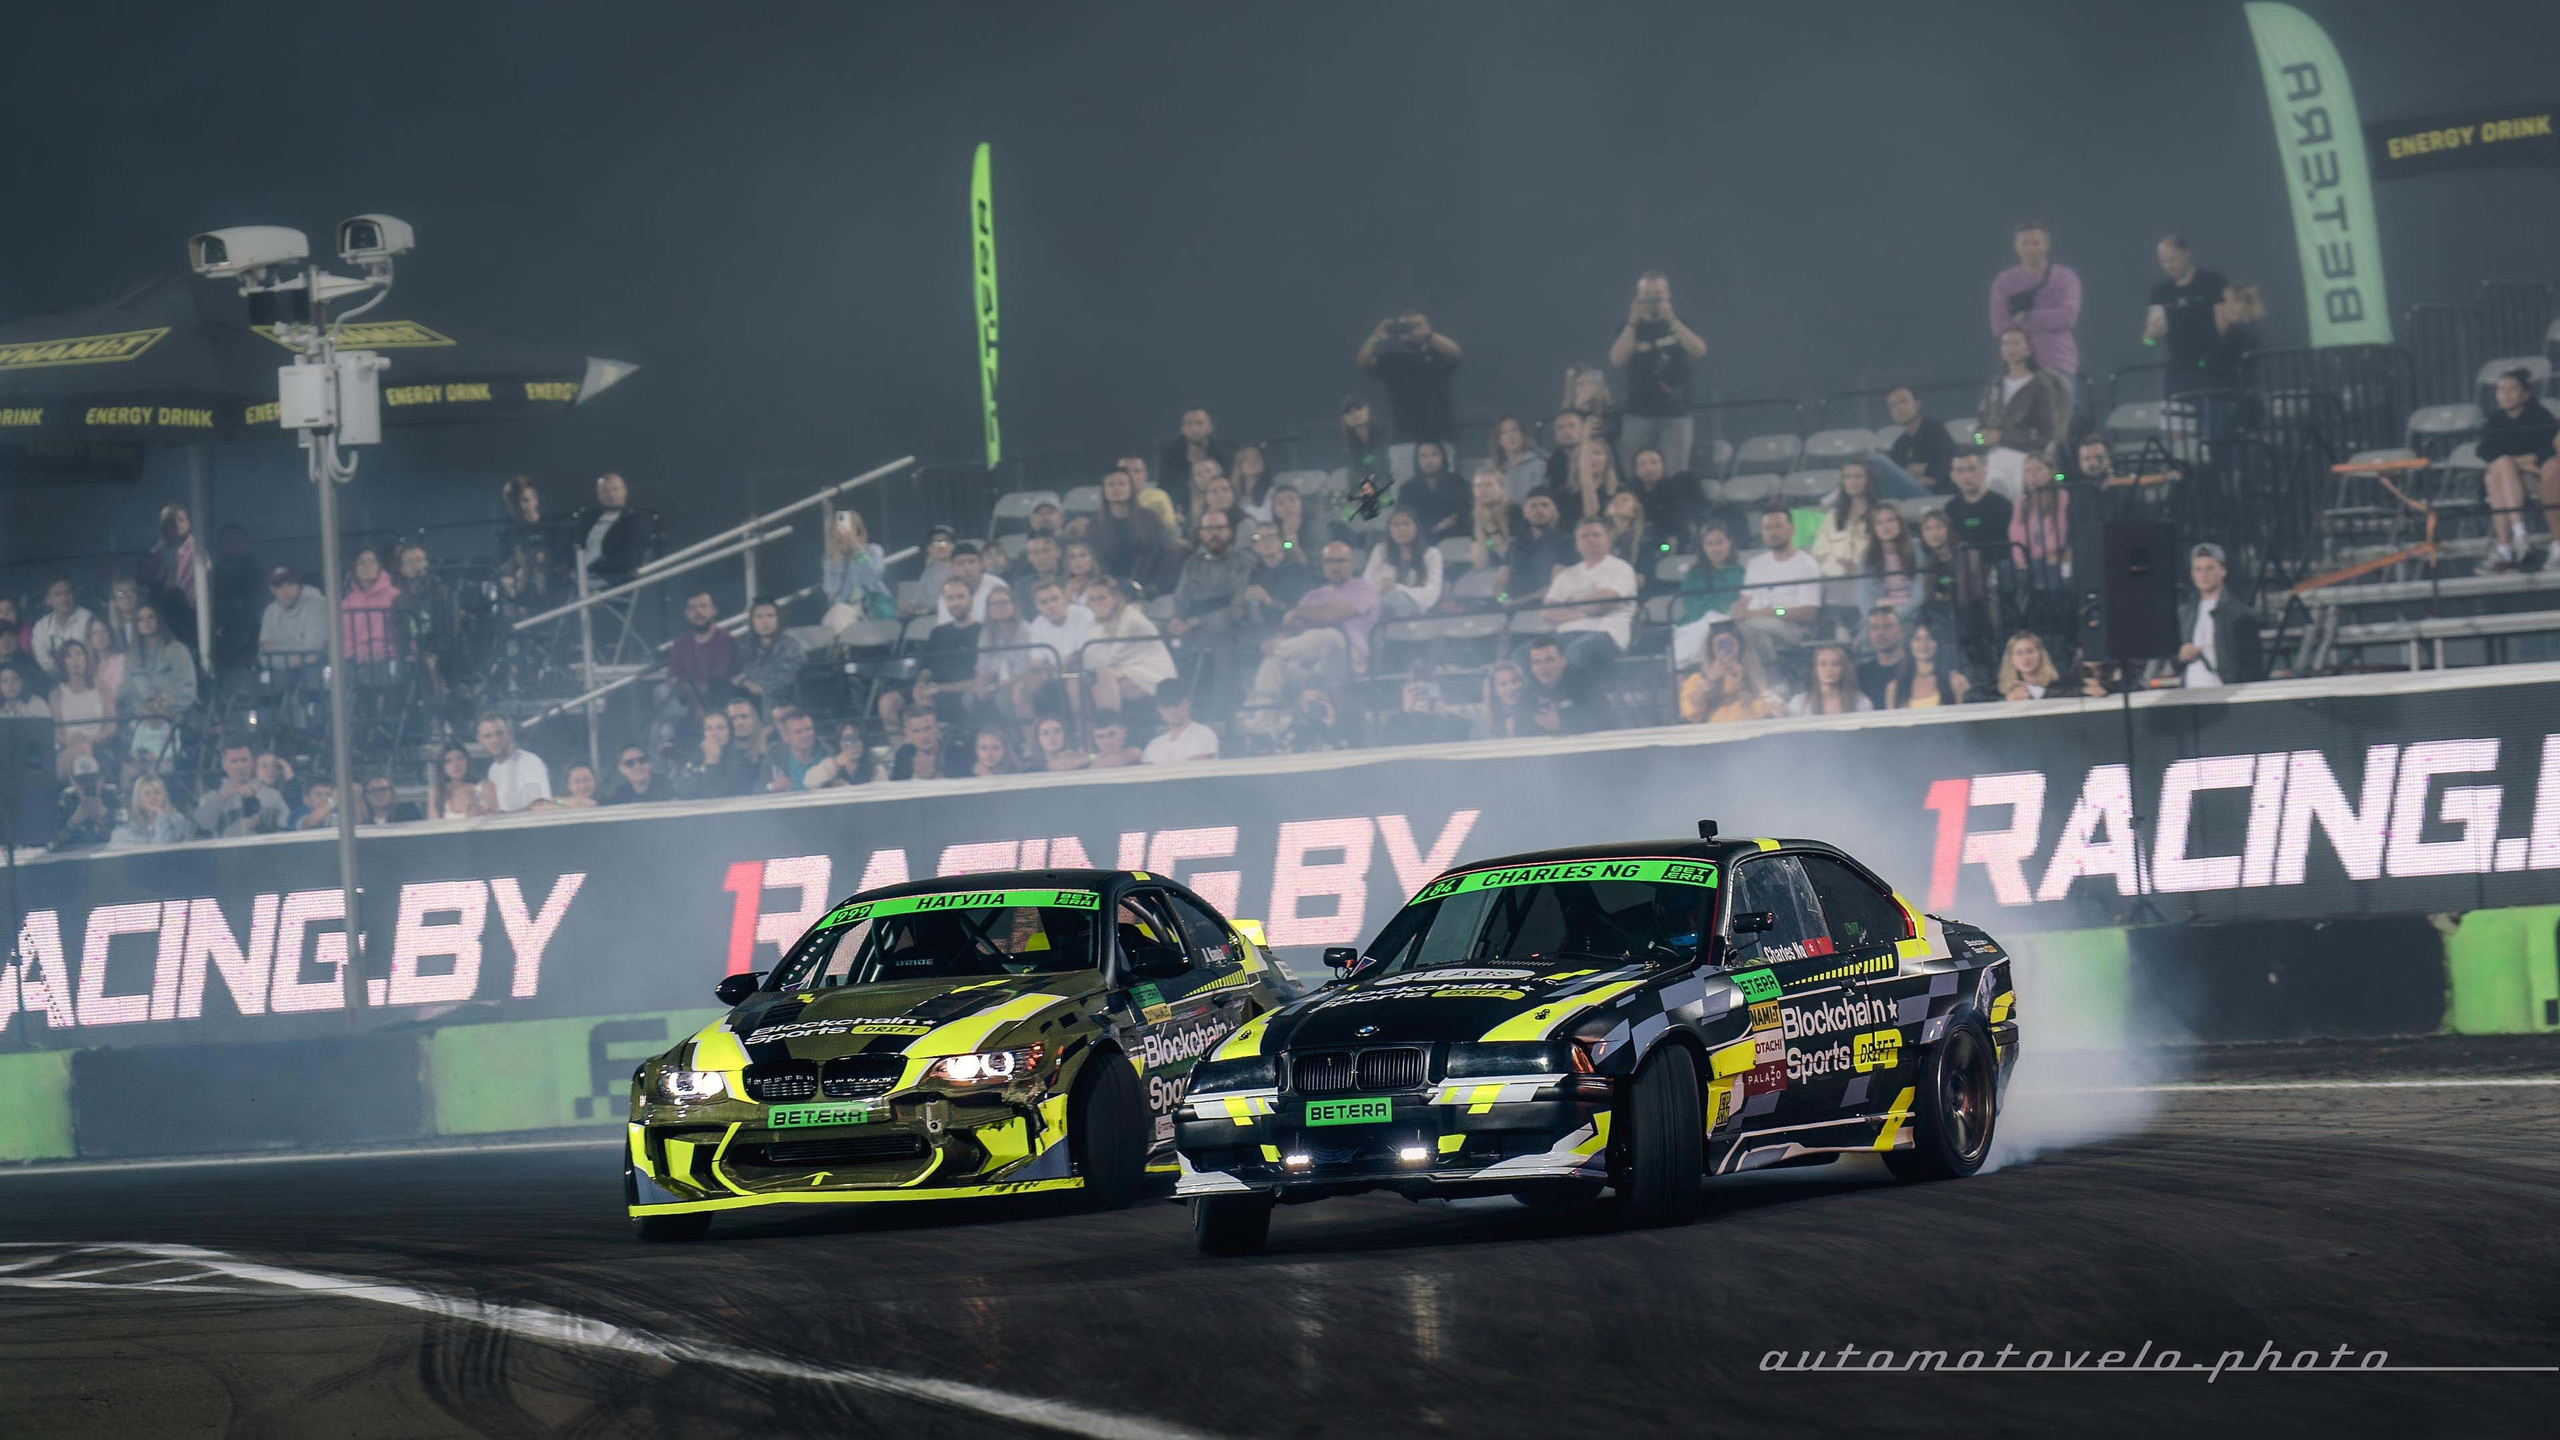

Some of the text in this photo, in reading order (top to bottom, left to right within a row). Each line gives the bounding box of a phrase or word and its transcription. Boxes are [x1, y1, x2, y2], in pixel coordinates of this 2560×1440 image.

[2387, 114, 2552, 159] ENERGY DRINK
[386, 382, 492, 406] ENERGY DRINK
[0, 408, 44, 426] RINK
[85, 406, 213, 428] ENERGY DRINK
[1482, 864, 1641, 887] CHARLES NG
[916, 893, 1005, 910] НАГУЛА
[836, 905, 871, 922] 999
[1764, 944, 1797, 964] Charles
[751, 1016, 917, 1037] Blockchain
[1781, 994, 1886, 1040] Blockchain
[744, 1026, 922, 1045] Sports DRIFT
[1786, 1039, 1896, 1085] Sports DRIFT
[1311, 1103, 1387, 1121] BET.ERA
